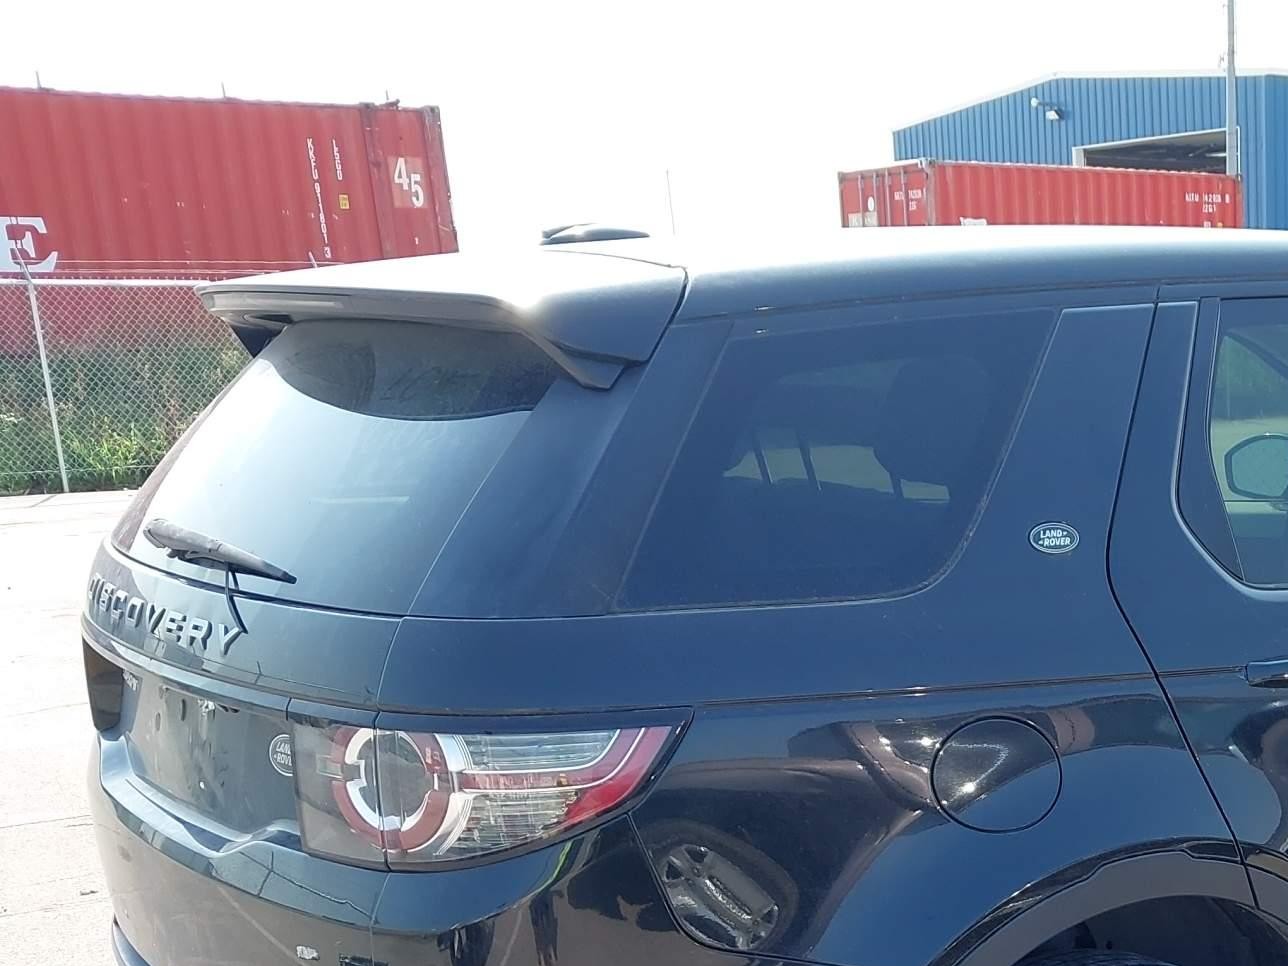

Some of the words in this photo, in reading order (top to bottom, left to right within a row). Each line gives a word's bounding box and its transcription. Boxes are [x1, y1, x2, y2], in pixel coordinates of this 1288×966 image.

[394, 157, 424, 208] 45
[1040, 529, 1063, 538] LAND
[1043, 536, 1071, 547] ROVER
[89, 573, 241, 656] DISCOVERY
